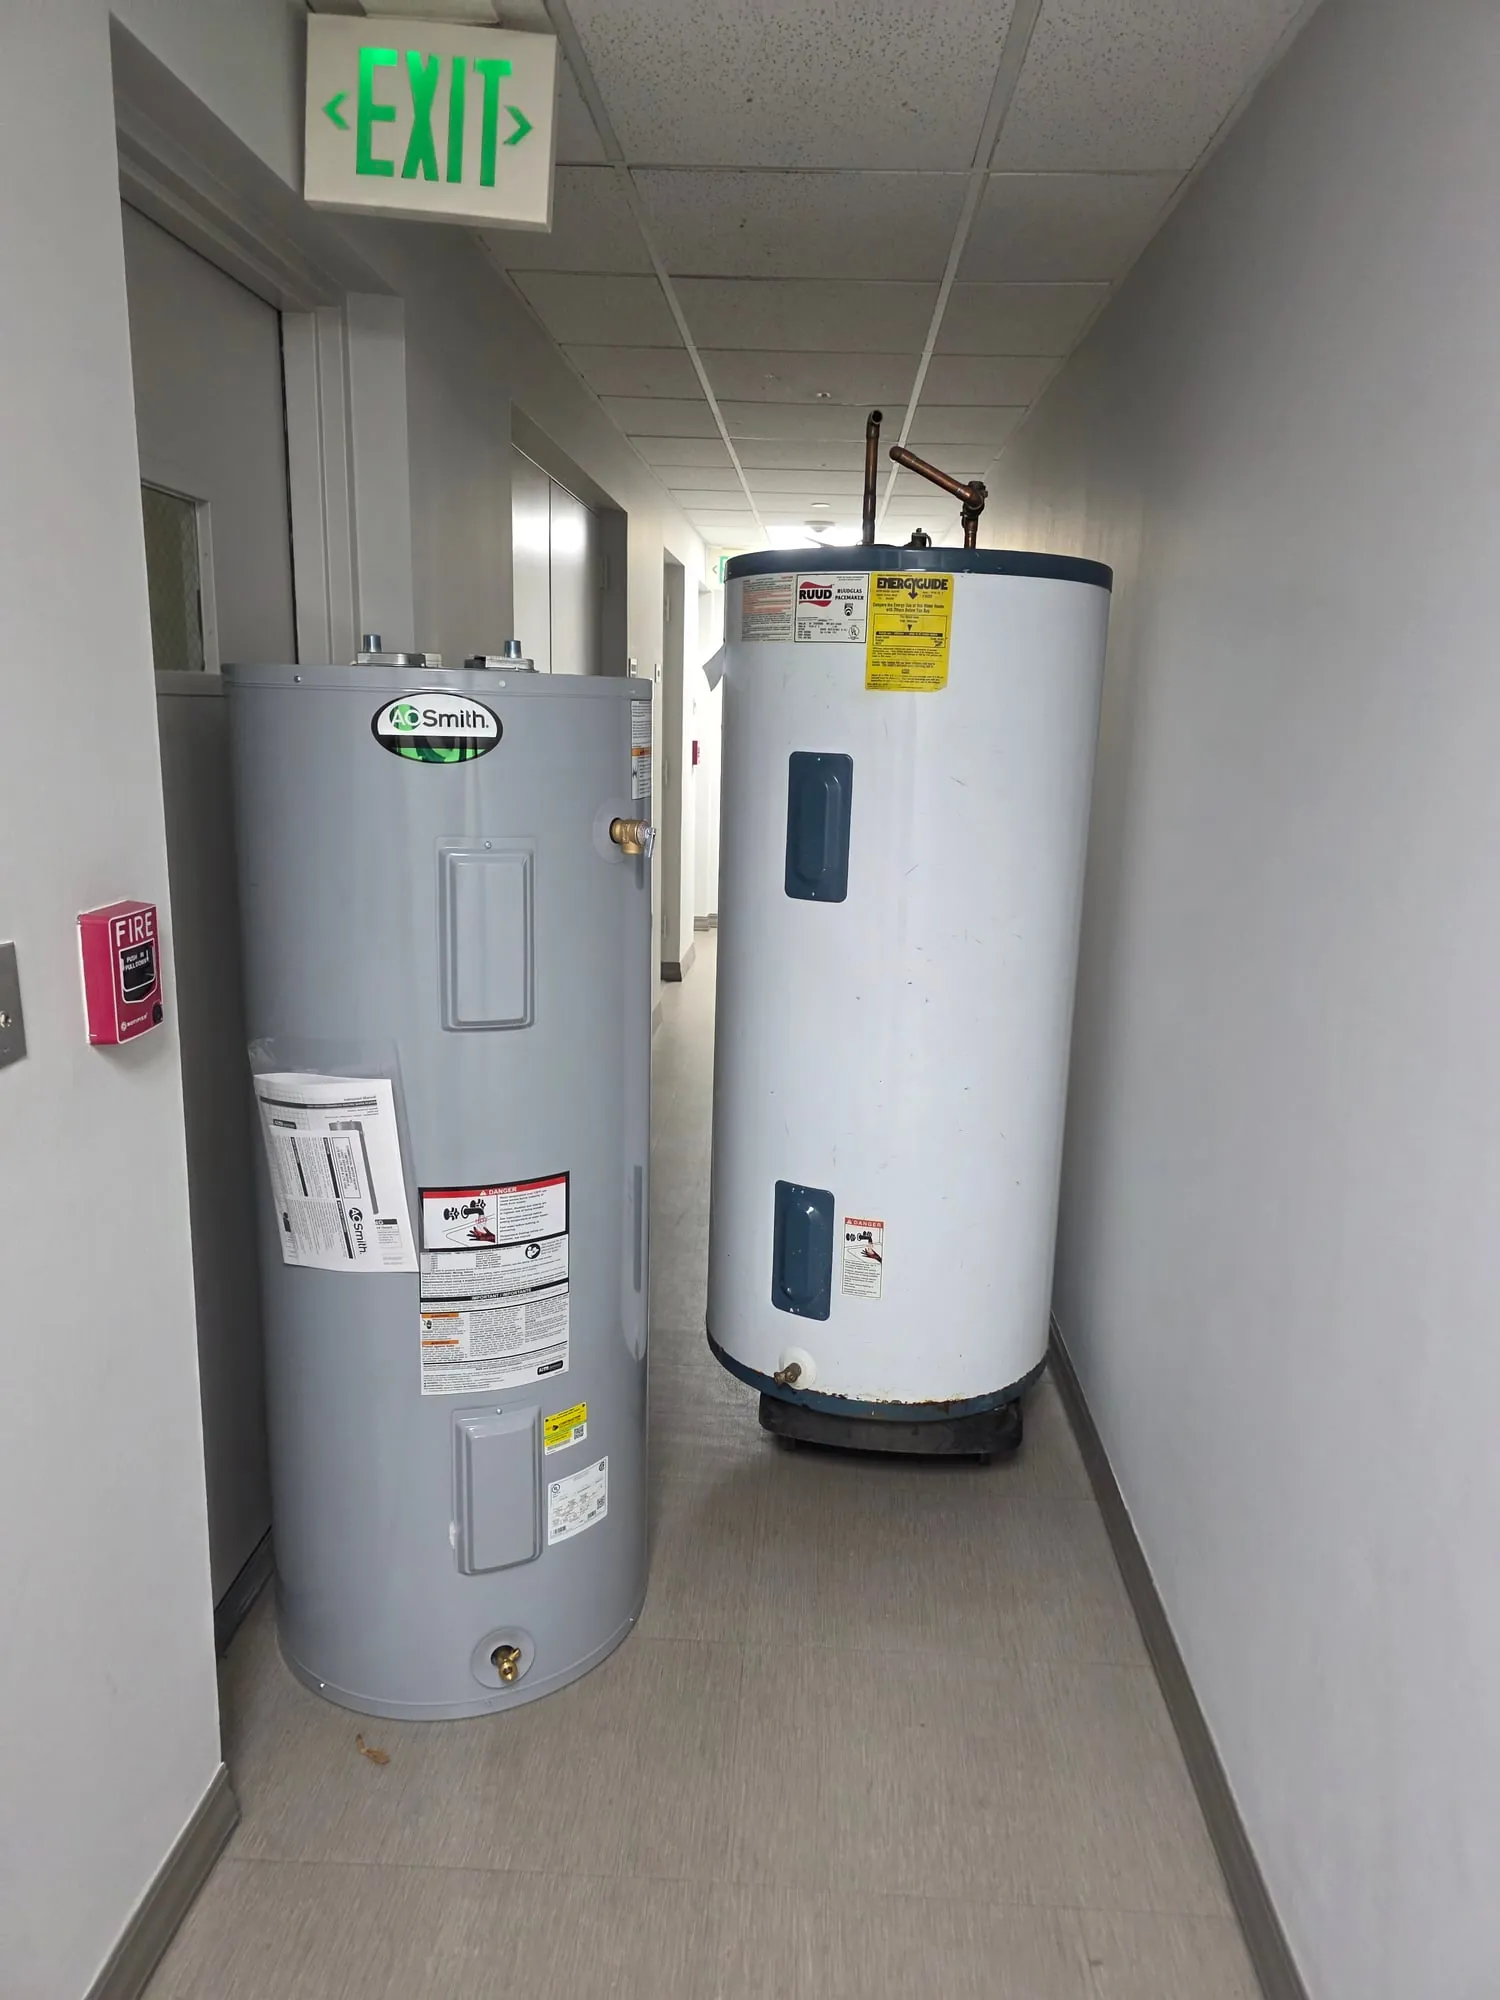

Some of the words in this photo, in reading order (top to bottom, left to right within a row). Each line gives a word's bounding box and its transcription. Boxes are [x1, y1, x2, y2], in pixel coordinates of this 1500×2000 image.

[356, 47, 513, 187] EXIT
[876, 577, 949, 590] ENERGYGUIDE
[799, 589, 832, 600] RUUD
[115, 912, 153, 947] FIRE
[126, 954, 138, 964] PUSH
[488, 1186, 517, 1195] DANGER
[471, 1292, 500, 1300] IMPORTANT
